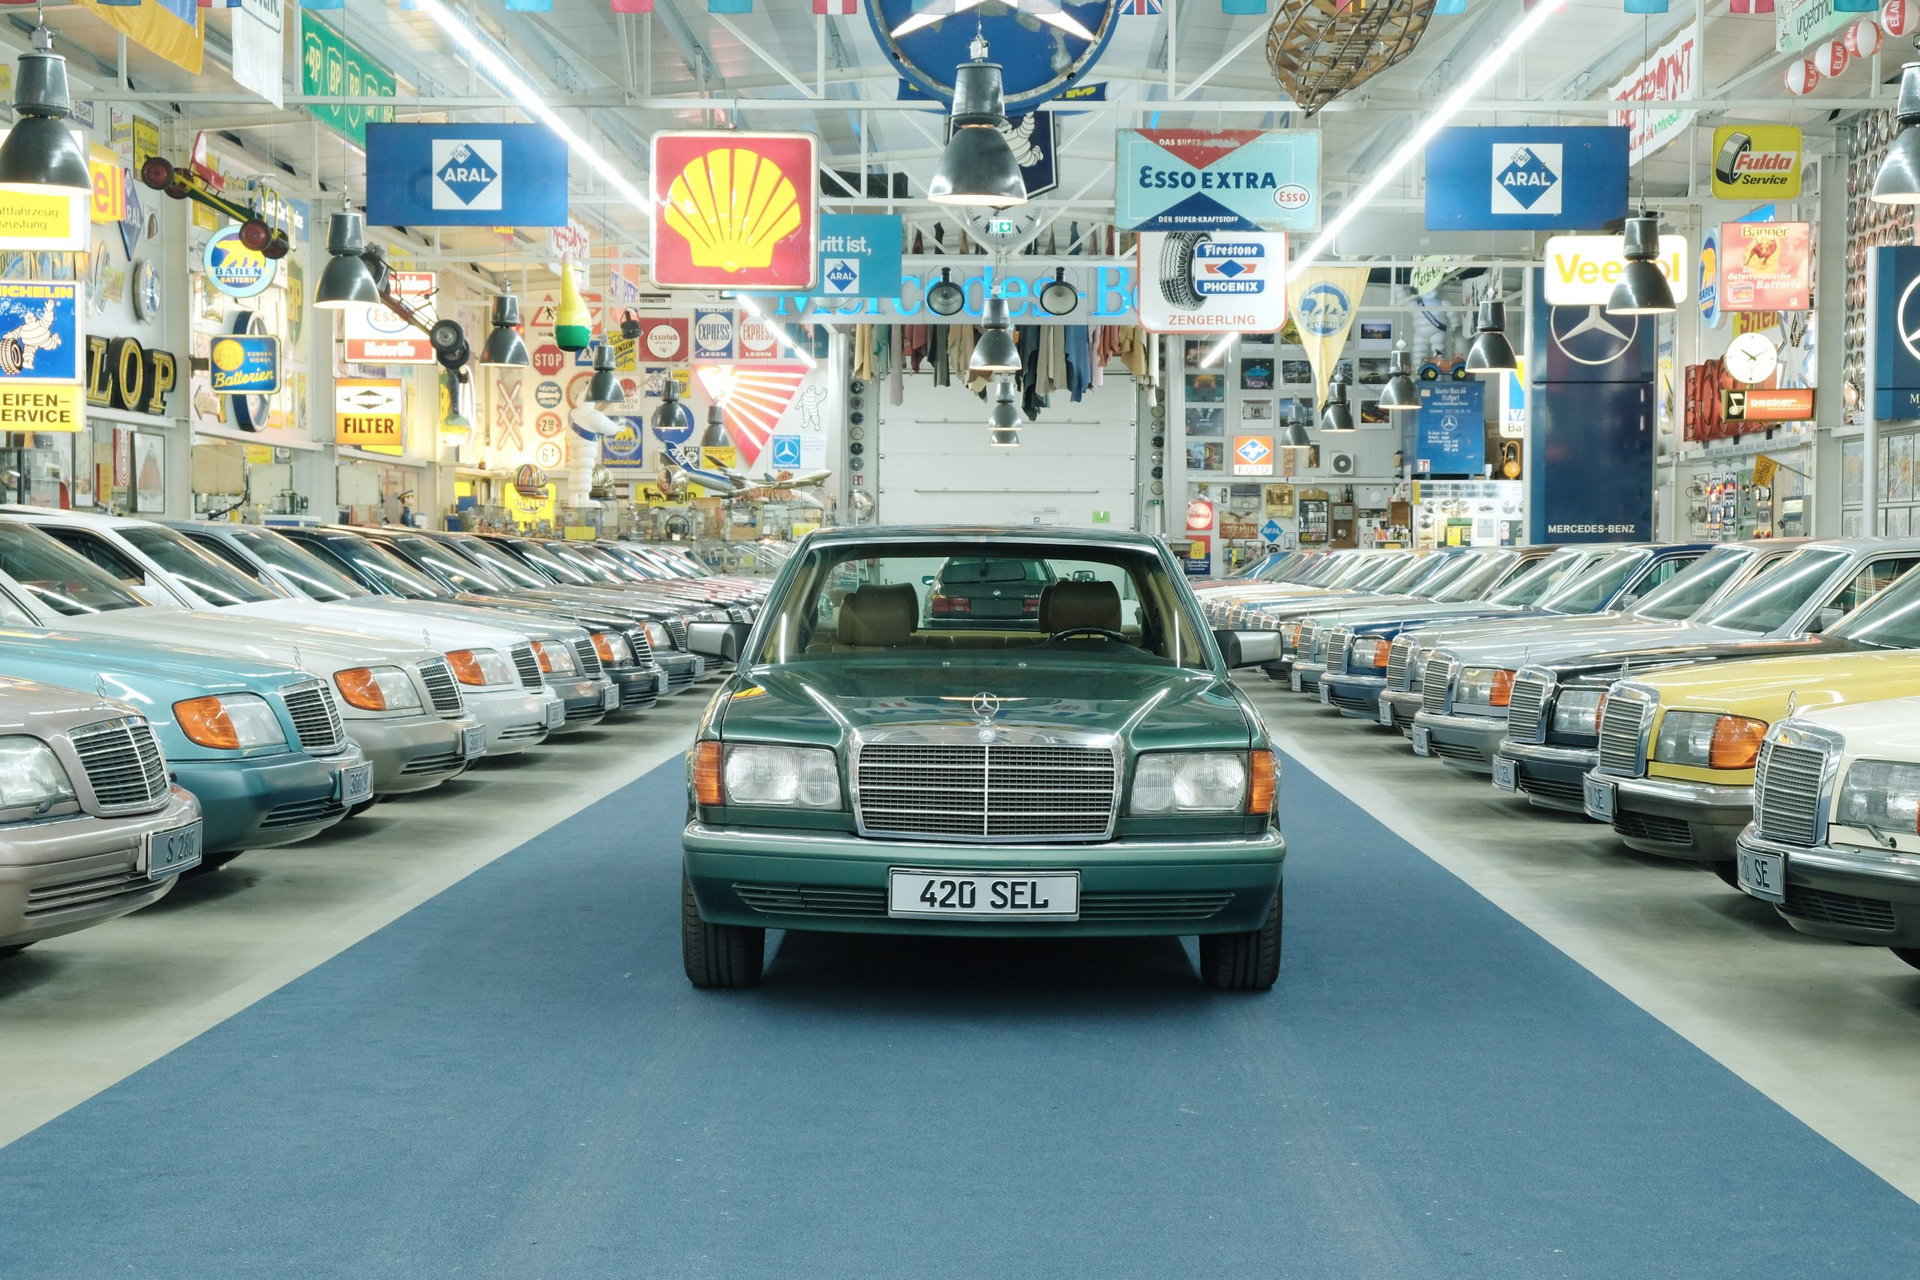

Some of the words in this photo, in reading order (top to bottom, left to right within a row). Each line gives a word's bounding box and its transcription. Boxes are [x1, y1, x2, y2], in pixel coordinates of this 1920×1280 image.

[1891, 1, 1900, 27] ELAN
[1846, 26, 1856, 52] ELAN
[1833, 45, 1844, 69] ELAN
[330, 59, 341, 95] BP
[1808, 63, 1816, 87] ELAN
[1159, 138, 1175, 146] DAS
[1735, 154, 1792, 170] Fulda
[443, 168, 491, 183] ARAL
[1139, 165, 1196, 189] ESSO
[1201, 172, 1277, 189] EXTRA
[1503, 172, 1551, 186] ARAL
[1742, 175, 1788, 185] Service
[1279, 191, 1306, 202] Esso
[1158, 215, 1172, 223] DER
[1742, 226, 1788, 237] Banner
[846, 236, 872, 256] ist,
[1203, 244, 1258, 257] Firestone
[830, 272, 854, 280] ARAL
[1554, 253, 1680, 285] Veel
[0, 285, 74, 299] ICHELIN
[1203, 281, 1258, 292] PHOENIX
[1168, 315, 1256, 325] ZENGERLING
[649, 333, 678, 341] Essolub
[698, 324, 730, 341] EXPRESS
[614, 340, 636, 356] UNLOP
[534, 353, 562, 367] STOP
[86, 339, 174, 412] LOP
[213, 368, 275, 388] Batterien
[3, 393, 70, 407] EIFEN-
[1, 410, 71, 423] ERVICE
[343, 418, 395, 434] FILTER
[1548, 524, 1635, 534] MERCEDES-BENZ
[166, 835, 173, 864] S
[1754, 858, 1770, 888] SE
[920, 880, 976, 909] 420
[990, 880, 1049, 909] SEL
